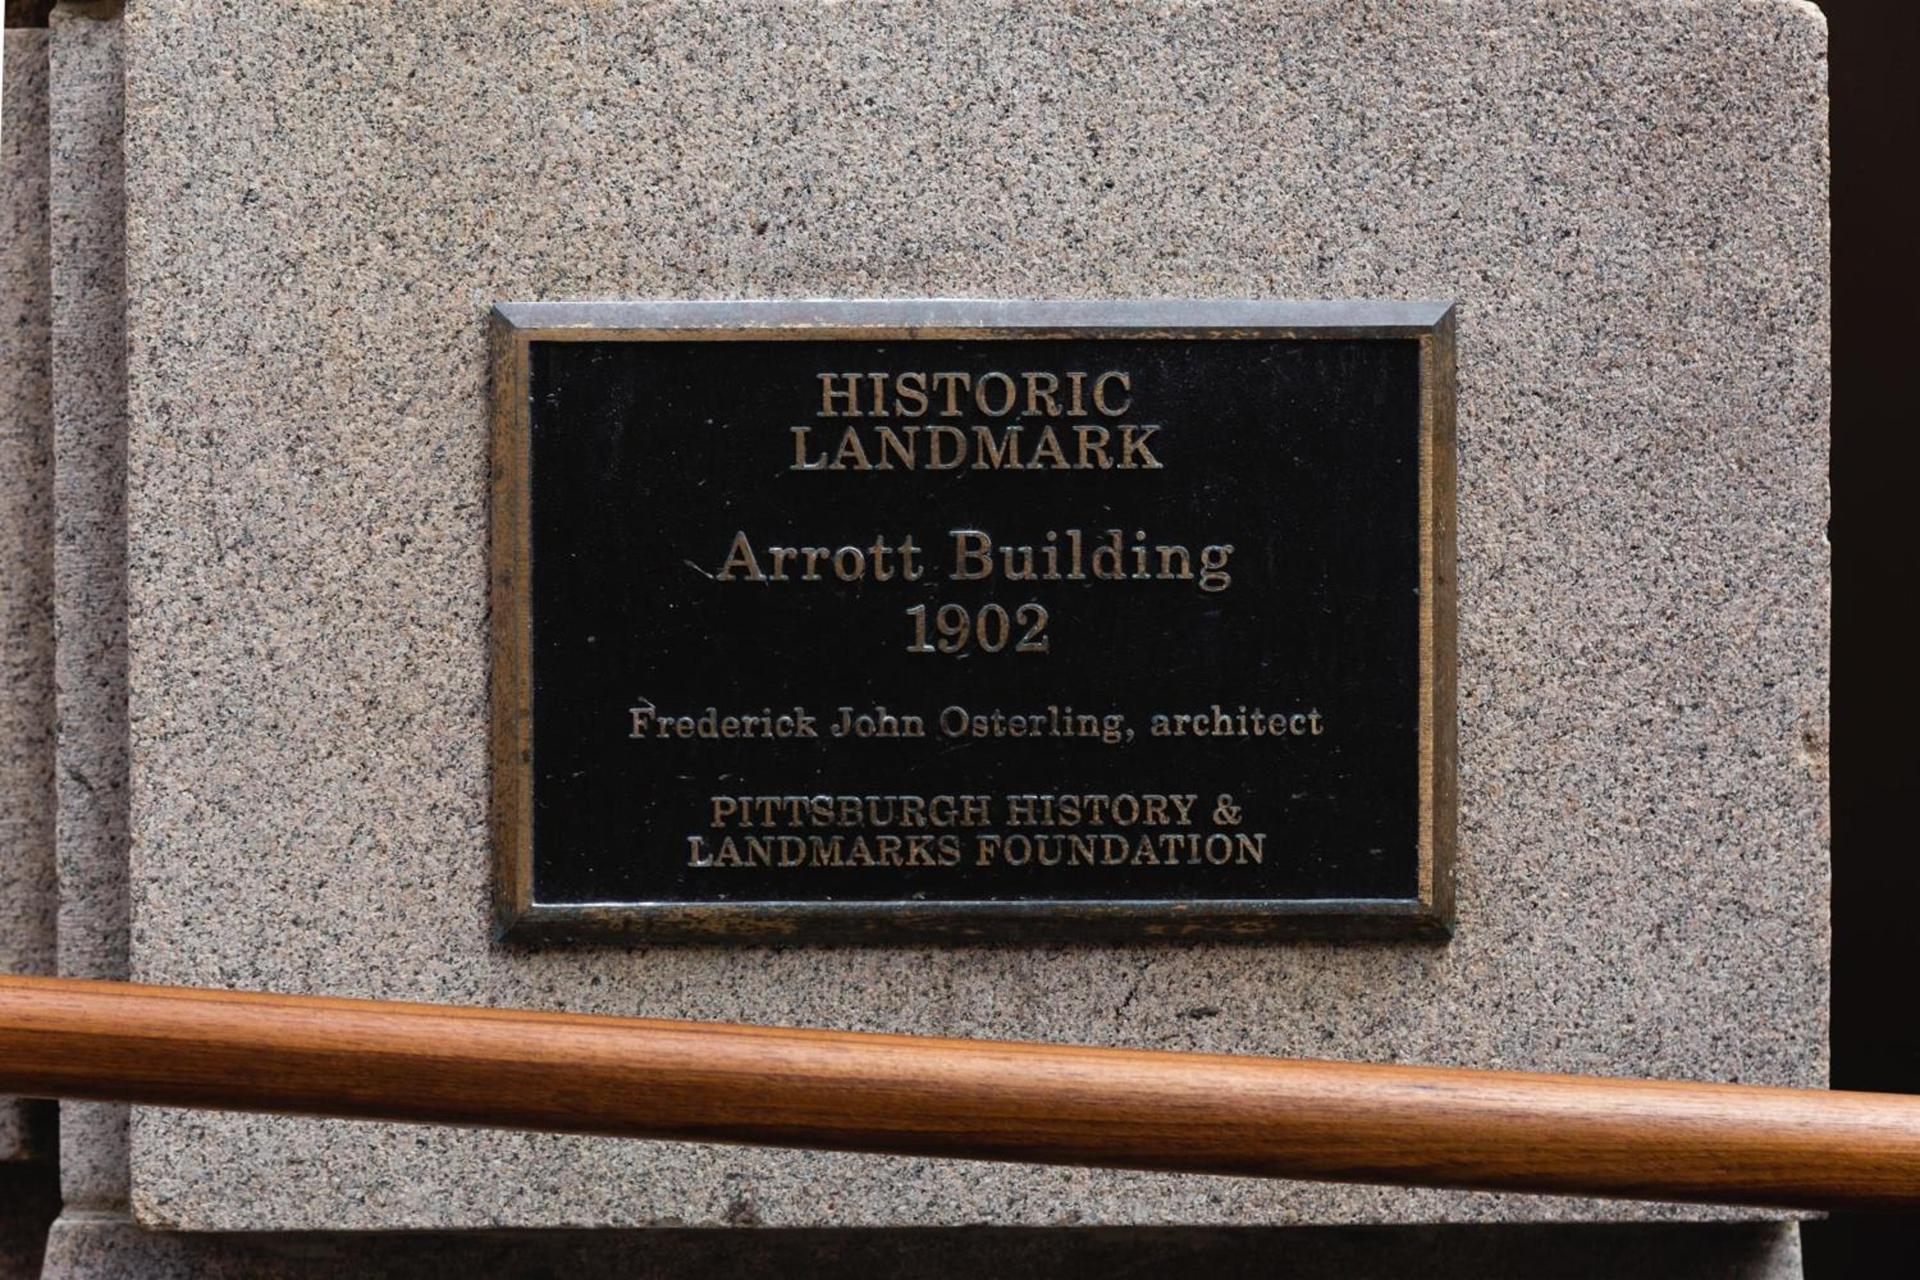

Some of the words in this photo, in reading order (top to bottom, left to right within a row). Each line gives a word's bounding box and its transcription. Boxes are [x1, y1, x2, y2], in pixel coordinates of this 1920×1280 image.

[816, 372, 1132, 417] HISTORIC
[790, 425, 1164, 470] LANDMARK
[716, 530, 925, 582] Arrott
[949, 529, 1236, 592] Building
[906, 603, 1051, 653] 1902
[628, 705, 818, 739] Frederick
[831, 706, 925, 738] John
[940, 706, 1135, 744] Osterling,
[1151, 706, 1325, 738] architect
[711, 795, 992, 828] PITTSBURGH
[1006, 795, 1198, 827] HISTORY
[1212, 795, 1243, 826] &
[688, 836, 962, 868] LANDMARKS
[977, 833, 1268, 868] FOUNDATION
